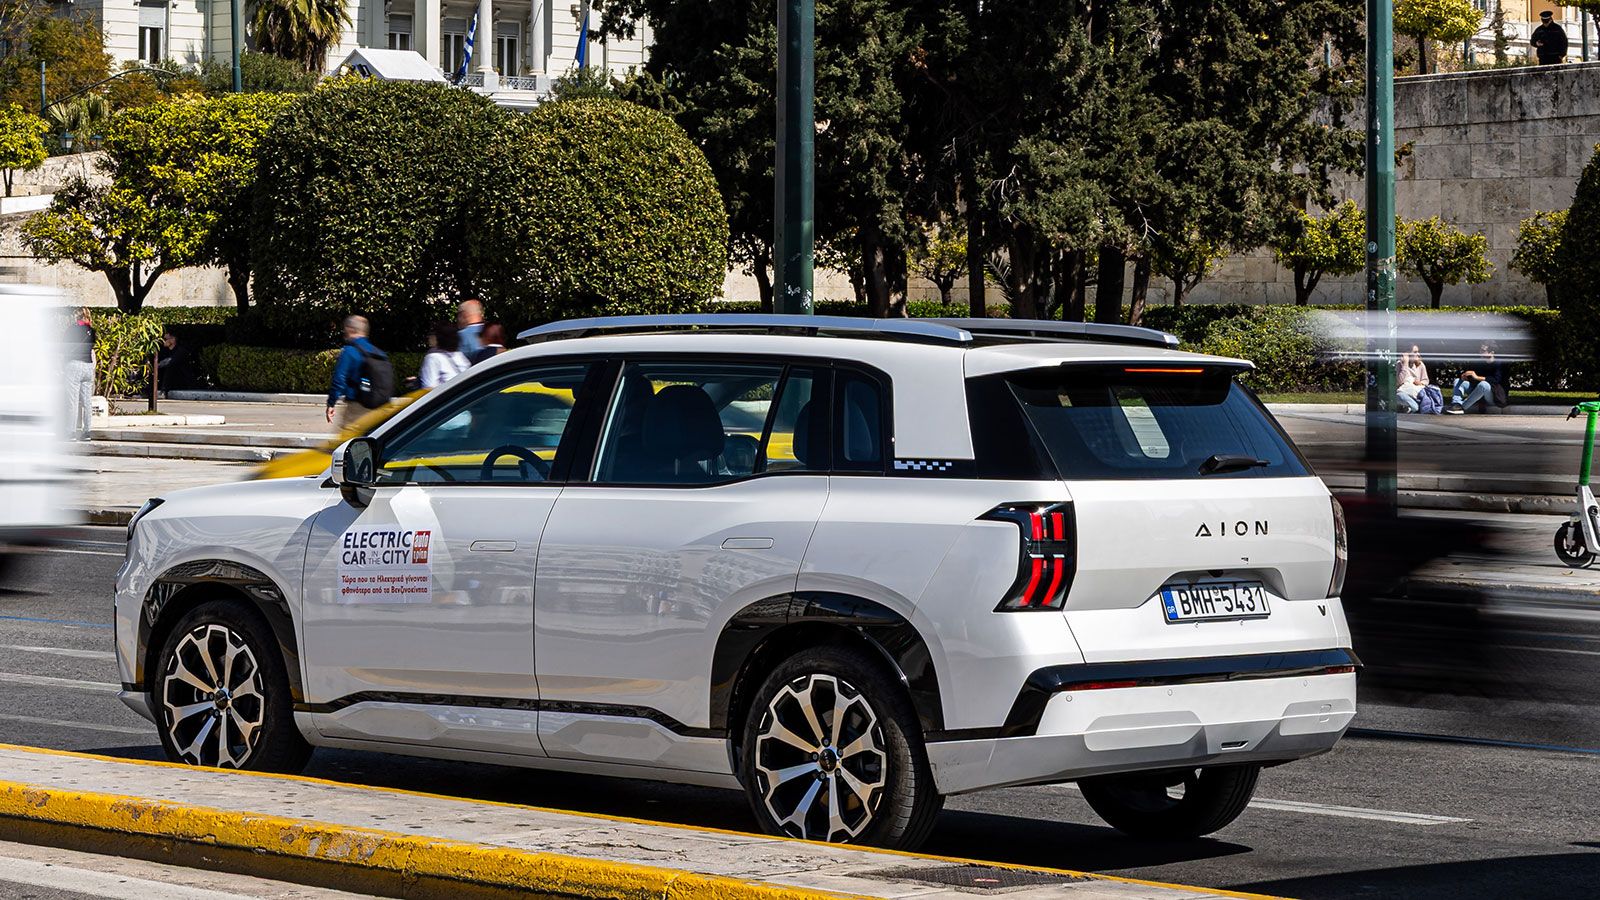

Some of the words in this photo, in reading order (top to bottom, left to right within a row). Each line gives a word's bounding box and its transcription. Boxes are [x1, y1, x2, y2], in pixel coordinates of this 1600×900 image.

[1195, 520, 1268, 537] AION
[343, 531, 413, 549] ELECTRIC
[342, 551, 367, 565] CAR
[382, 550, 410, 564] CITY
[341, 575, 356, 585] Τώρα
[377, 574, 404, 584] Ηλεκτρικά
[405, 574, 428, 584] γίνονται
[372, 586, 382, 594] από
[1166, 606, 1177, 614] GR
[1317, 605, 1326, 616] V
